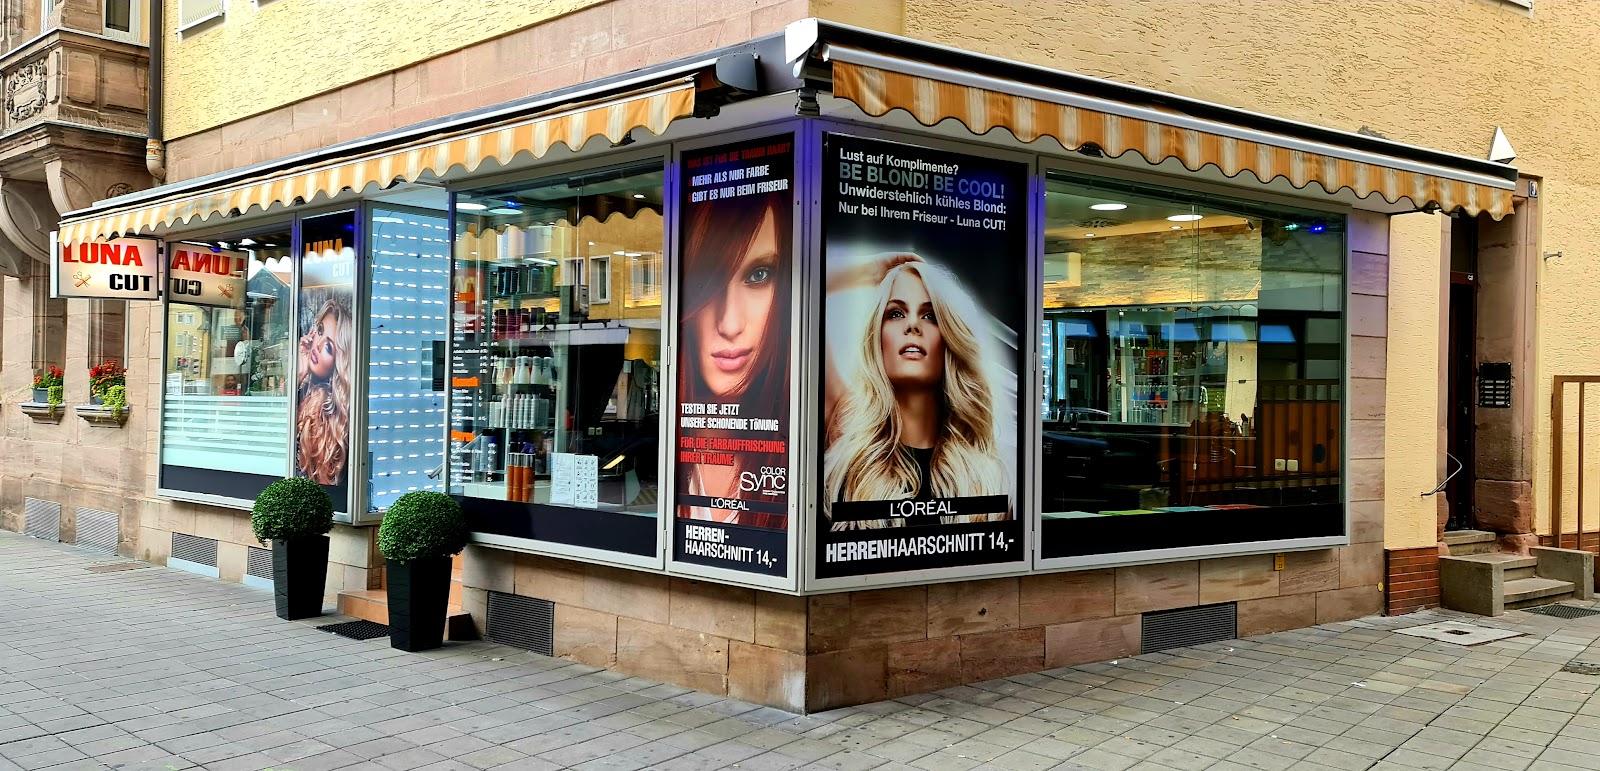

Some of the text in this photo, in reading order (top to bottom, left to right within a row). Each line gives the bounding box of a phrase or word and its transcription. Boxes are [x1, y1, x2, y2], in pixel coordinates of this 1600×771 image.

[703, 155, 713, 166] IST
[729, 150, 739, 162] SIE
[741, 146, 765, 160] TRAUM
[840, 148, 959, 175] Lust auf Komplimente?
[692, 164, 769, 186] MEHR ALS NUR FARBE
[839, 162, 1005, 199] BE BLOND! BE COOL!
[692, 178, 788, 203] GIBT ES NUR BEIM FRISEUR
[839, 182, 1007, 215] Unwiderstehlich kühles Blond:
[838, 201, 858, 214] Nur
[861, 204, 878, 217] bei
[880, 206, 910, 221] Ihrem
[913, 210, 948, 224] Friseur
[957, 215, 981, 228] Luna
[983, 218, 1006, 231] CUT!
[63, 243, 143, 267] LUNA
[109, 273, 153, 292] CUT
[681, 403, 740, 416] TESTEN SIE JETZT
[681, 416, 706, 428] UNSERE
[707, 417, 747, 430] SCHONENDE
[681, 437, 785, 453] FÜR DIE FARBAUFFRISCHUNG
[681, 451, 734, 465] IHRER TRÄUME
[739, 471, 785, 491] Sync
[760, 466, 786, 476] COLOR
[890, 499, 957, 517] L'ORÉAL
[685, 524, 730, 543] HERREN-
[685, 539, 777, 568] HAARSCHNITT 14,-
[826, 531, 1015, 563] HERRENHAARSCHNITT 14,-
